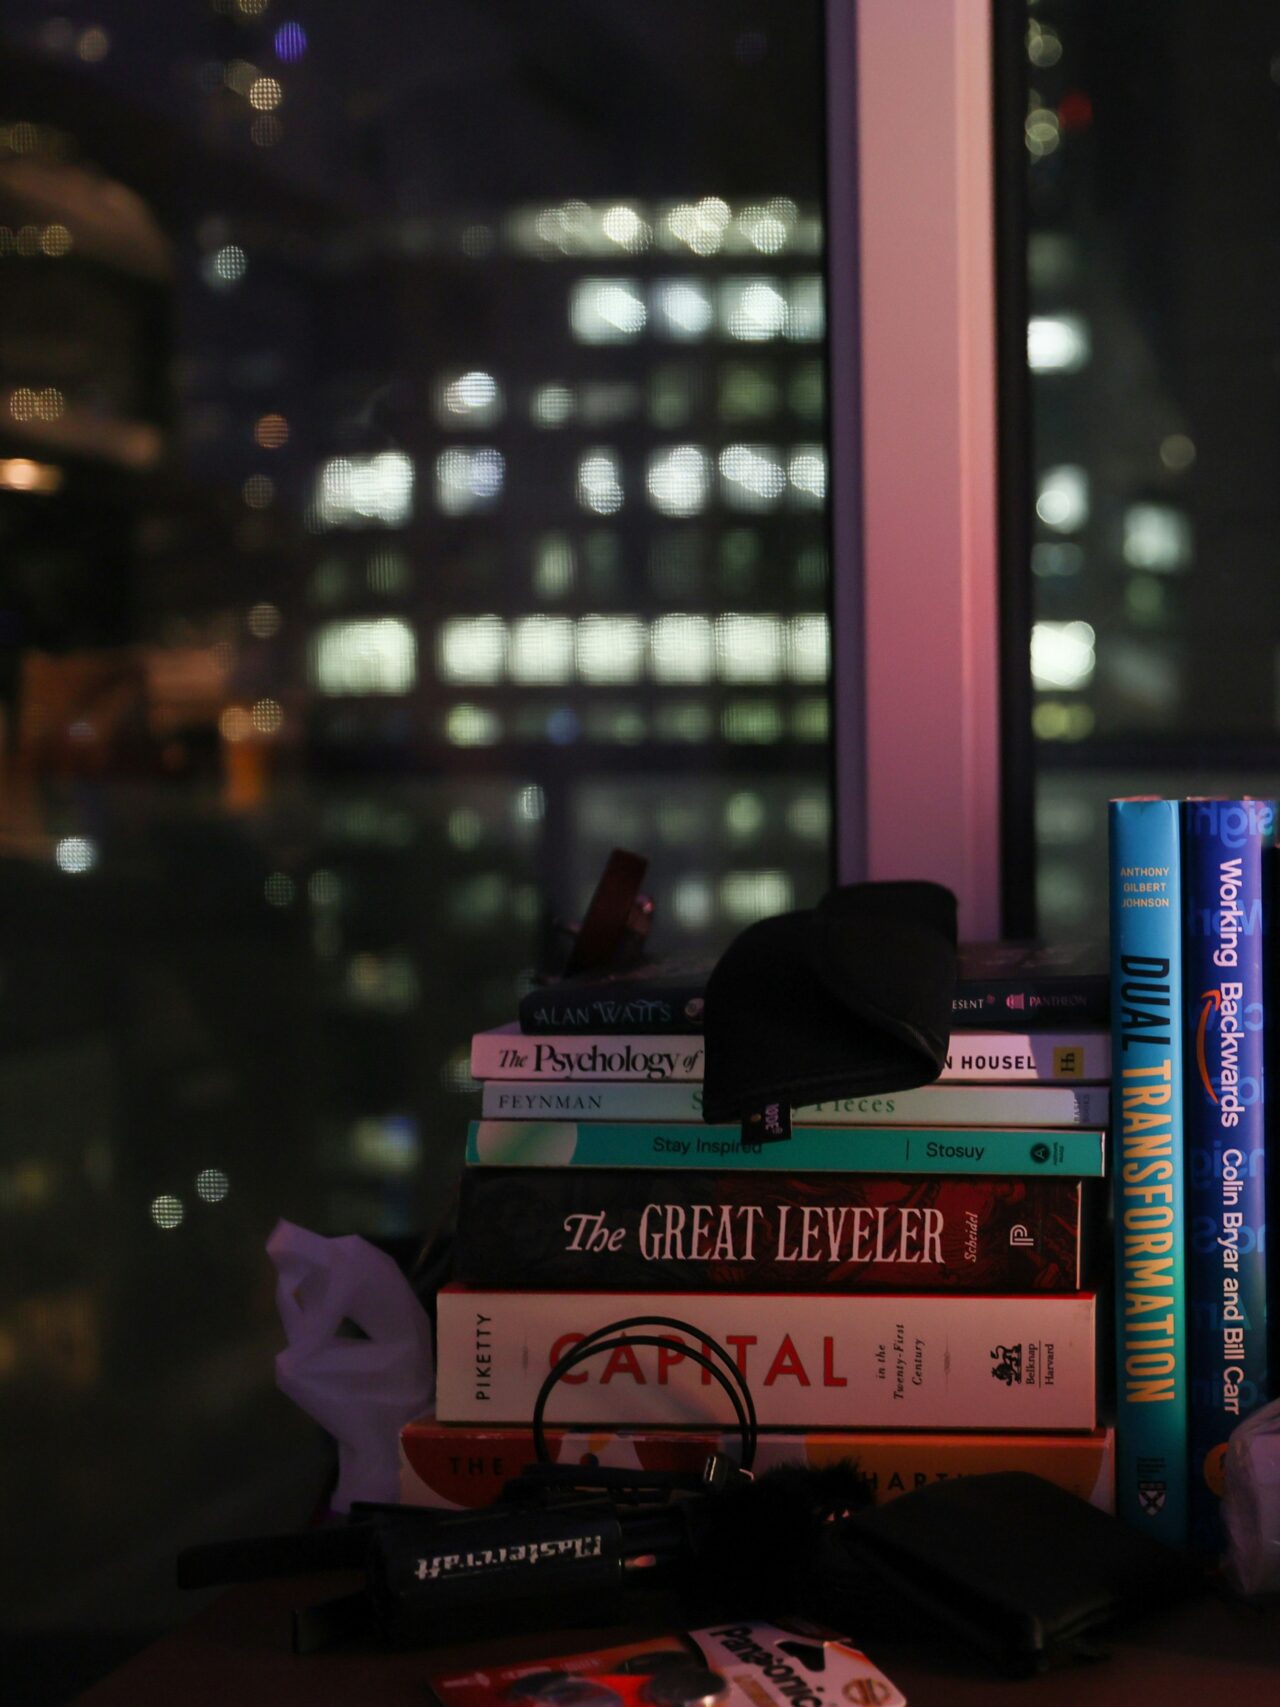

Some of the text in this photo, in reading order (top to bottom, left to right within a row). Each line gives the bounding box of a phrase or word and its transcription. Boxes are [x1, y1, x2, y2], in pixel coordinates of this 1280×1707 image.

[1120, 866, 1170, 877] ANTHONY
[1122, 882, 1167, 893] GILBERT
[1120, 897, 1170, 908] JOHNSON
[1212, 858, 1244, 968] Working
[533, 999, 673, 1025] ALAN WATTS
[1029, 994, 1089, 1007] PANTHEON
[1119, 955, 1171, 1051] DUAL
[500, 1044, 704, 1079] The Psychology of
[961, 1055, 1037, 1070] HOUSEL
[1219, 981, 1246, 1128] Backwards
[499, 1094, 603, 1110] FEYNMAN
[653, 1136, 763, 1156] Stay Inspired
[926, 1141, 985, 1161] Stosuy
[1221, 1148, 1244, 1206] Colin
[563, 1203, 946, 1265] The GREAT LEVELER
[963, 1211, 979, 1264] Scheidel
[1120, 1059, 1176, 1403] TRANSFORMATION
[1216, 1212, 1244, 1273] Bryar
[1222, 1277, 1245, 1320] and
[475, 1312, 492, 1400] PIKETTY
[549, 1332, 848, 1388] CAPITAL
[875, 1344, 886, 1380] in the
[893, 1323, 906, 1400] Twenty-First
[911, 1338, 926, 1386] Century
[1026, 1343, 1038, 1385] Belknap
[1044, 1343, 1054, 1386] Harvard
[1223, 1327, 1246, 1360] Bill
[1222, 1365, 1246, 1416] Carr
[450, 1457, 503, 1475] THE
[414, 1535, 603, 1580] Mastercraft
